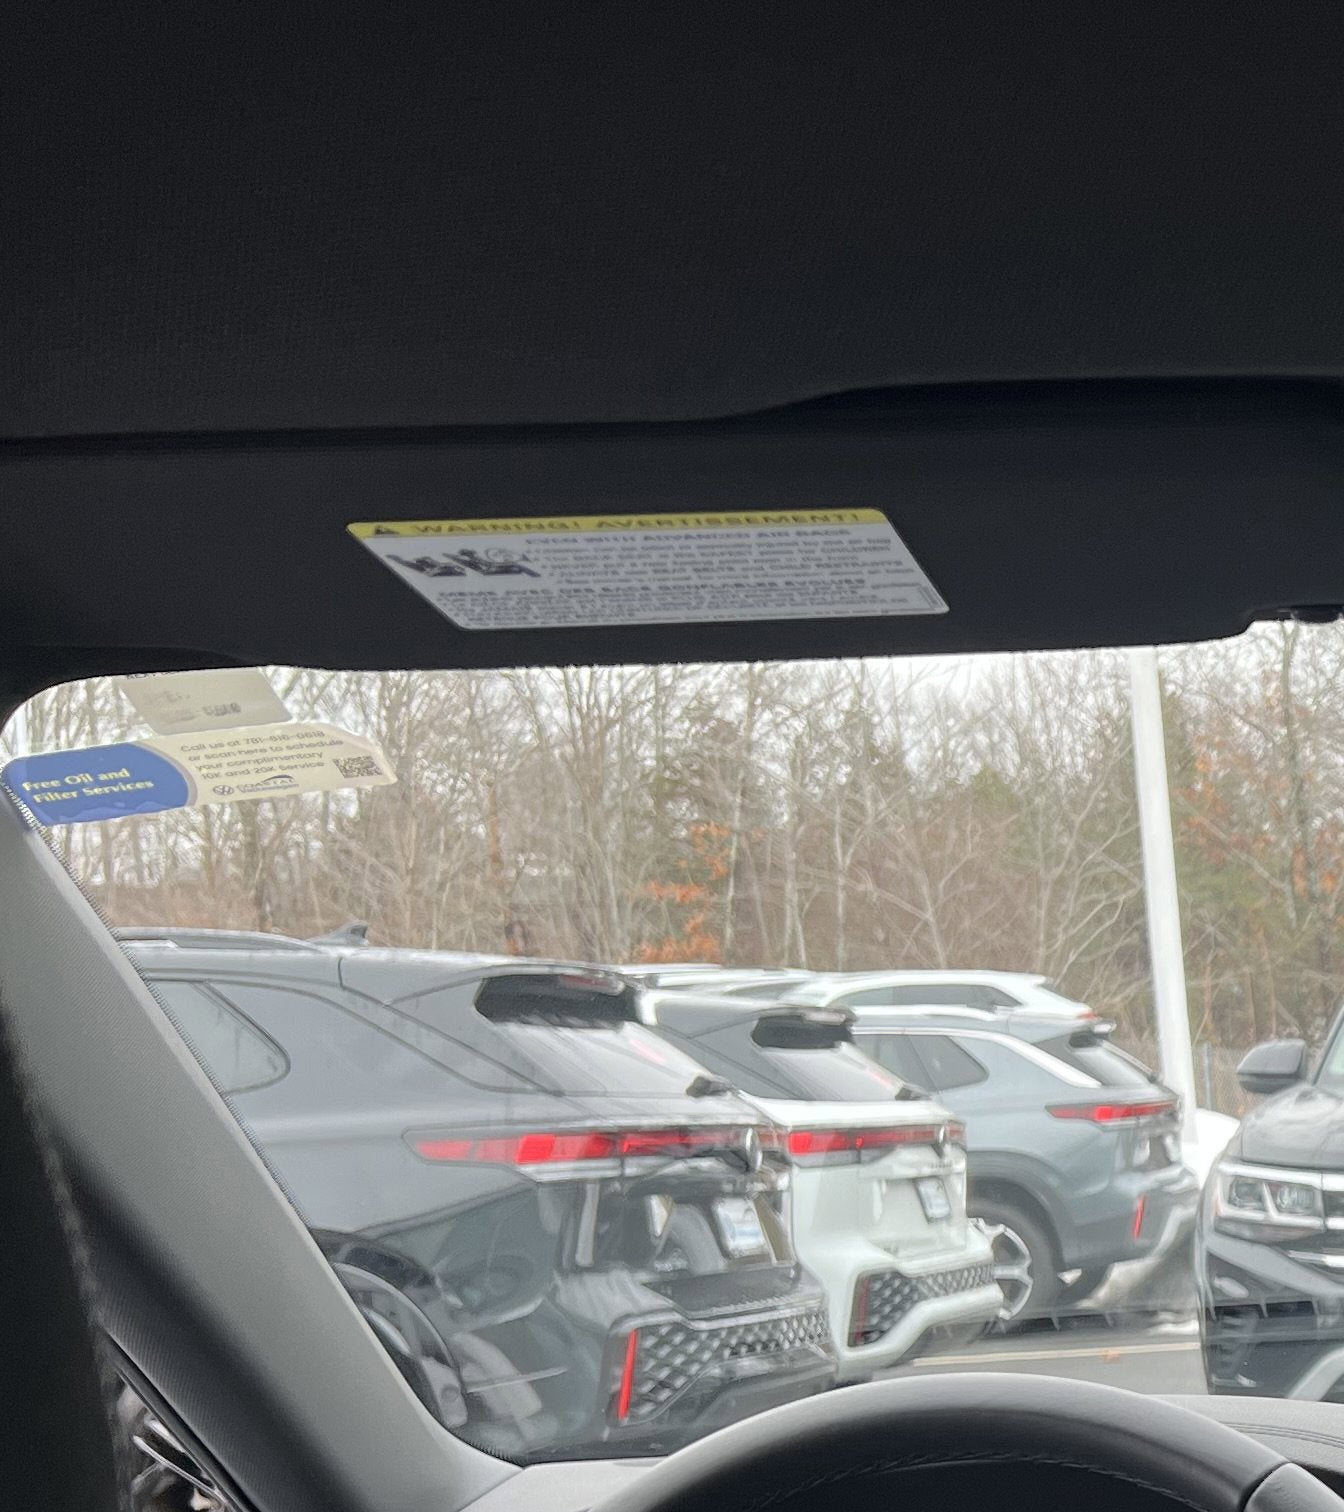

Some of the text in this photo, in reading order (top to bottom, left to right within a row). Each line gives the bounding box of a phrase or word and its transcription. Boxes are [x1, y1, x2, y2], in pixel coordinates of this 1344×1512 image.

[22, 767, 131, 792] Free Oil and
[33, 780, 155, 804] Filter Services
